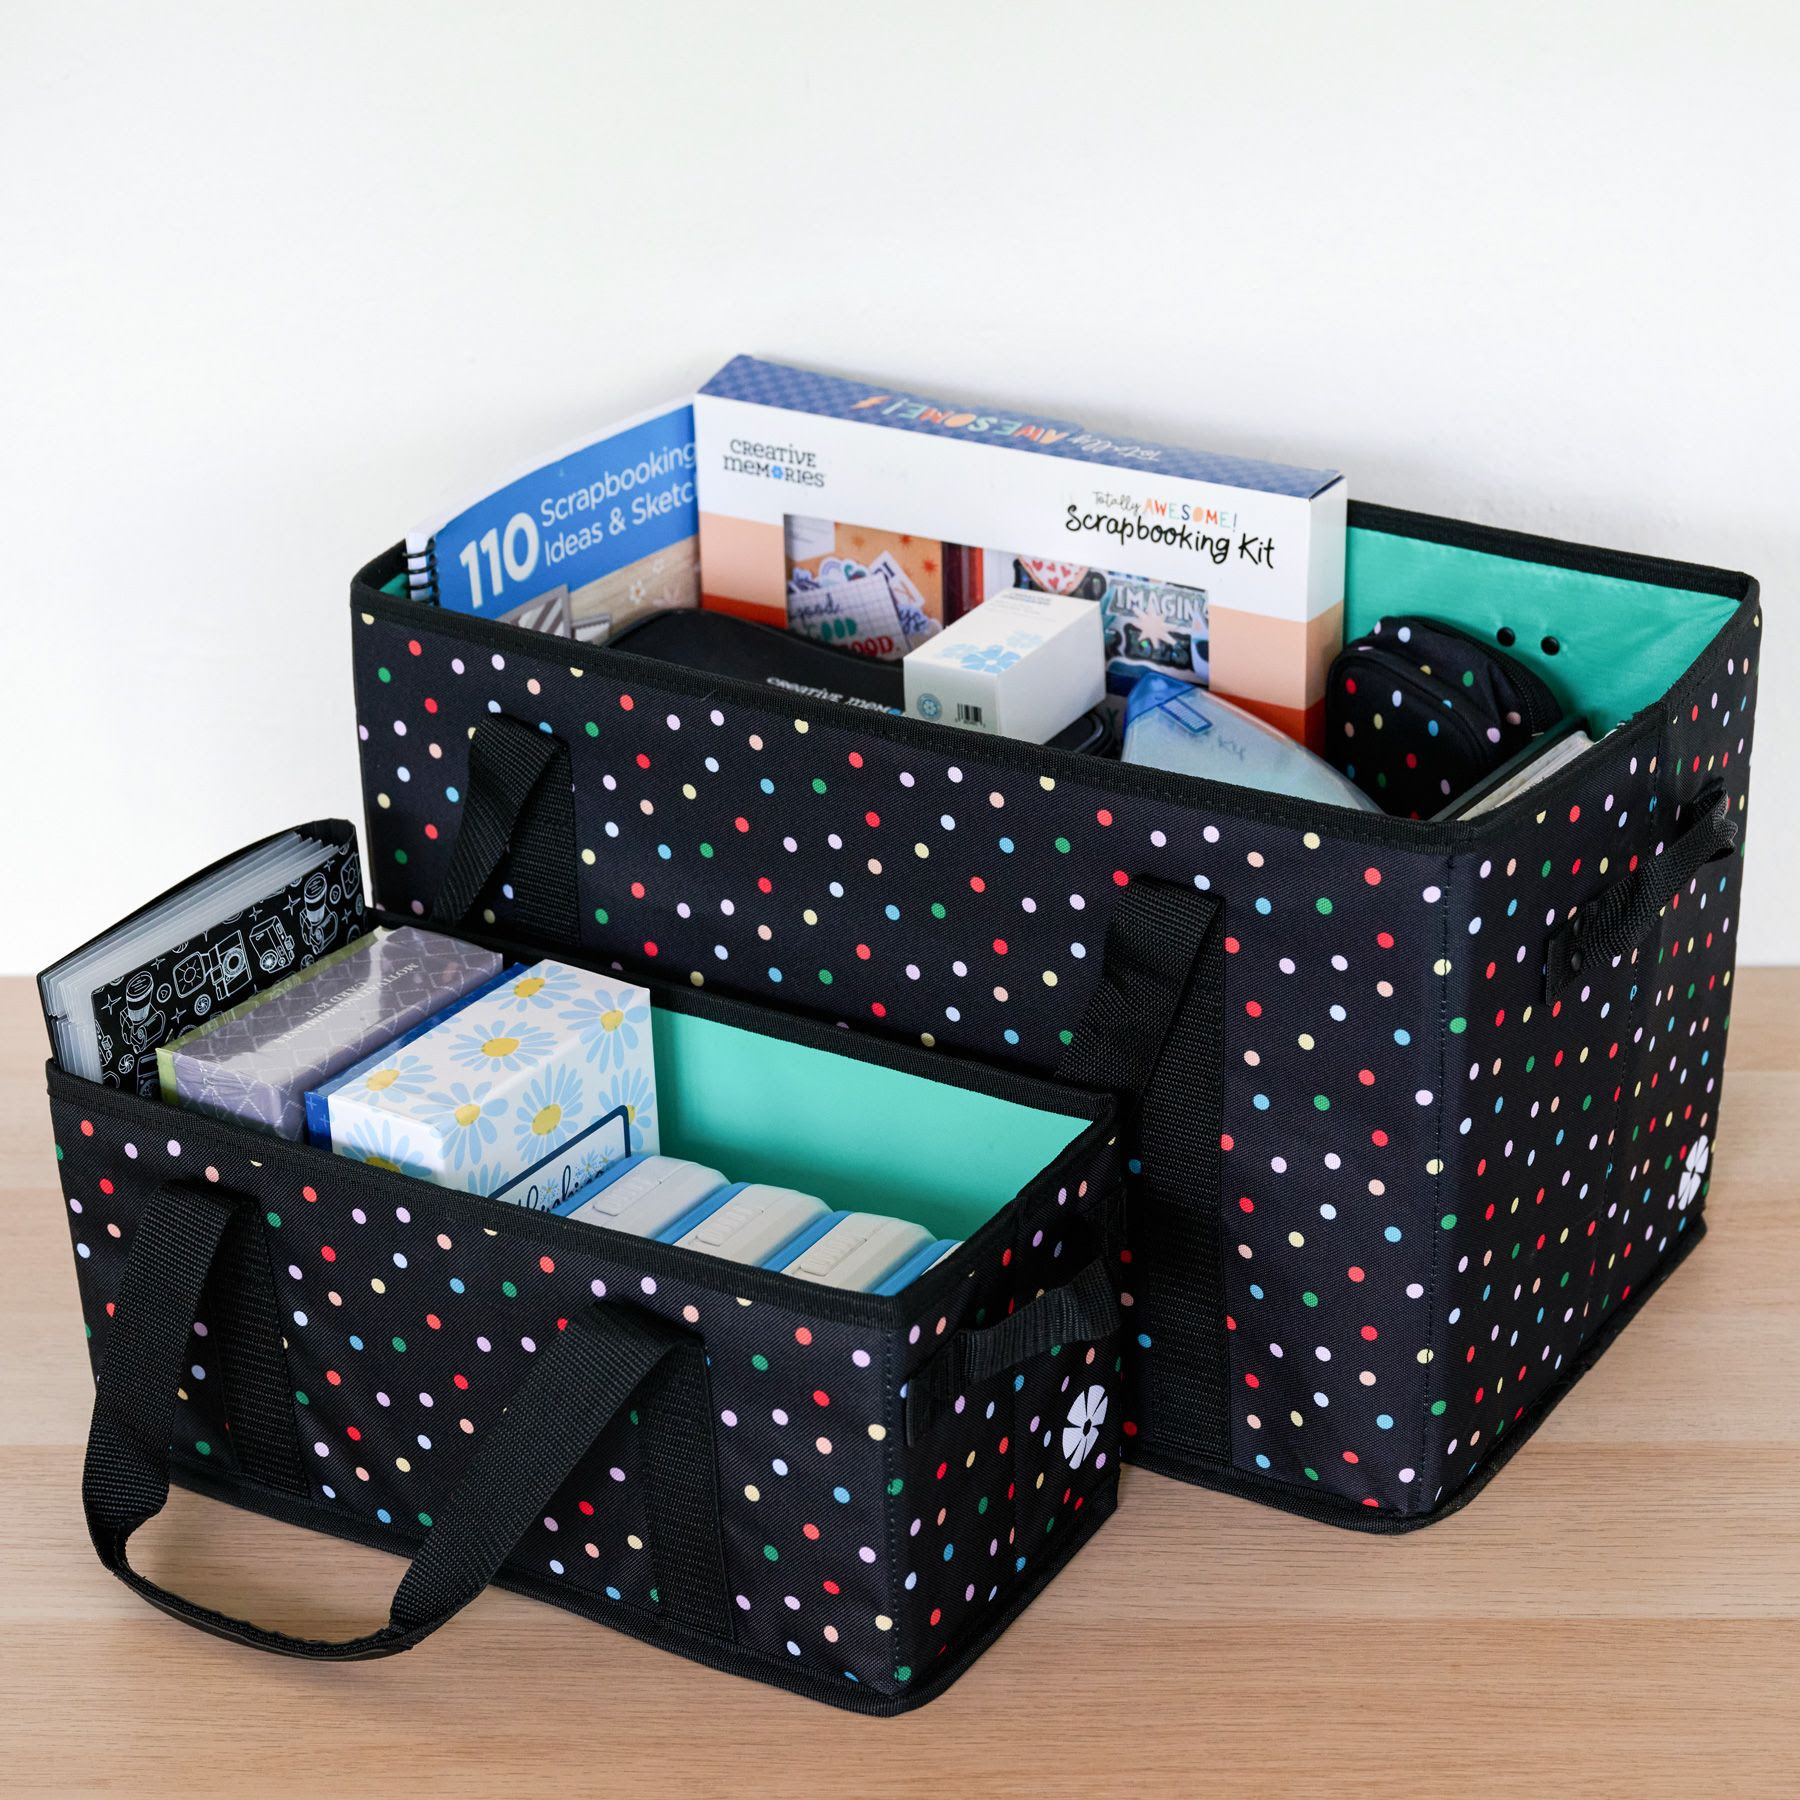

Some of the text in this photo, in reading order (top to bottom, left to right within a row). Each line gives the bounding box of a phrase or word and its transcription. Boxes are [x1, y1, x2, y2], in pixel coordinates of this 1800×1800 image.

[540, 442, 696, 527] Scrapbooking
[1092, 490, 1239, 533] Totally AWESOME!
[459, 511, 540, 609] 110
[544, 481, 697, 566] Ideas & Sketc
[1065, 504, 1275, 570] Scrapbooking Kit
[304, 980, 367, 1018] CARD KIT
